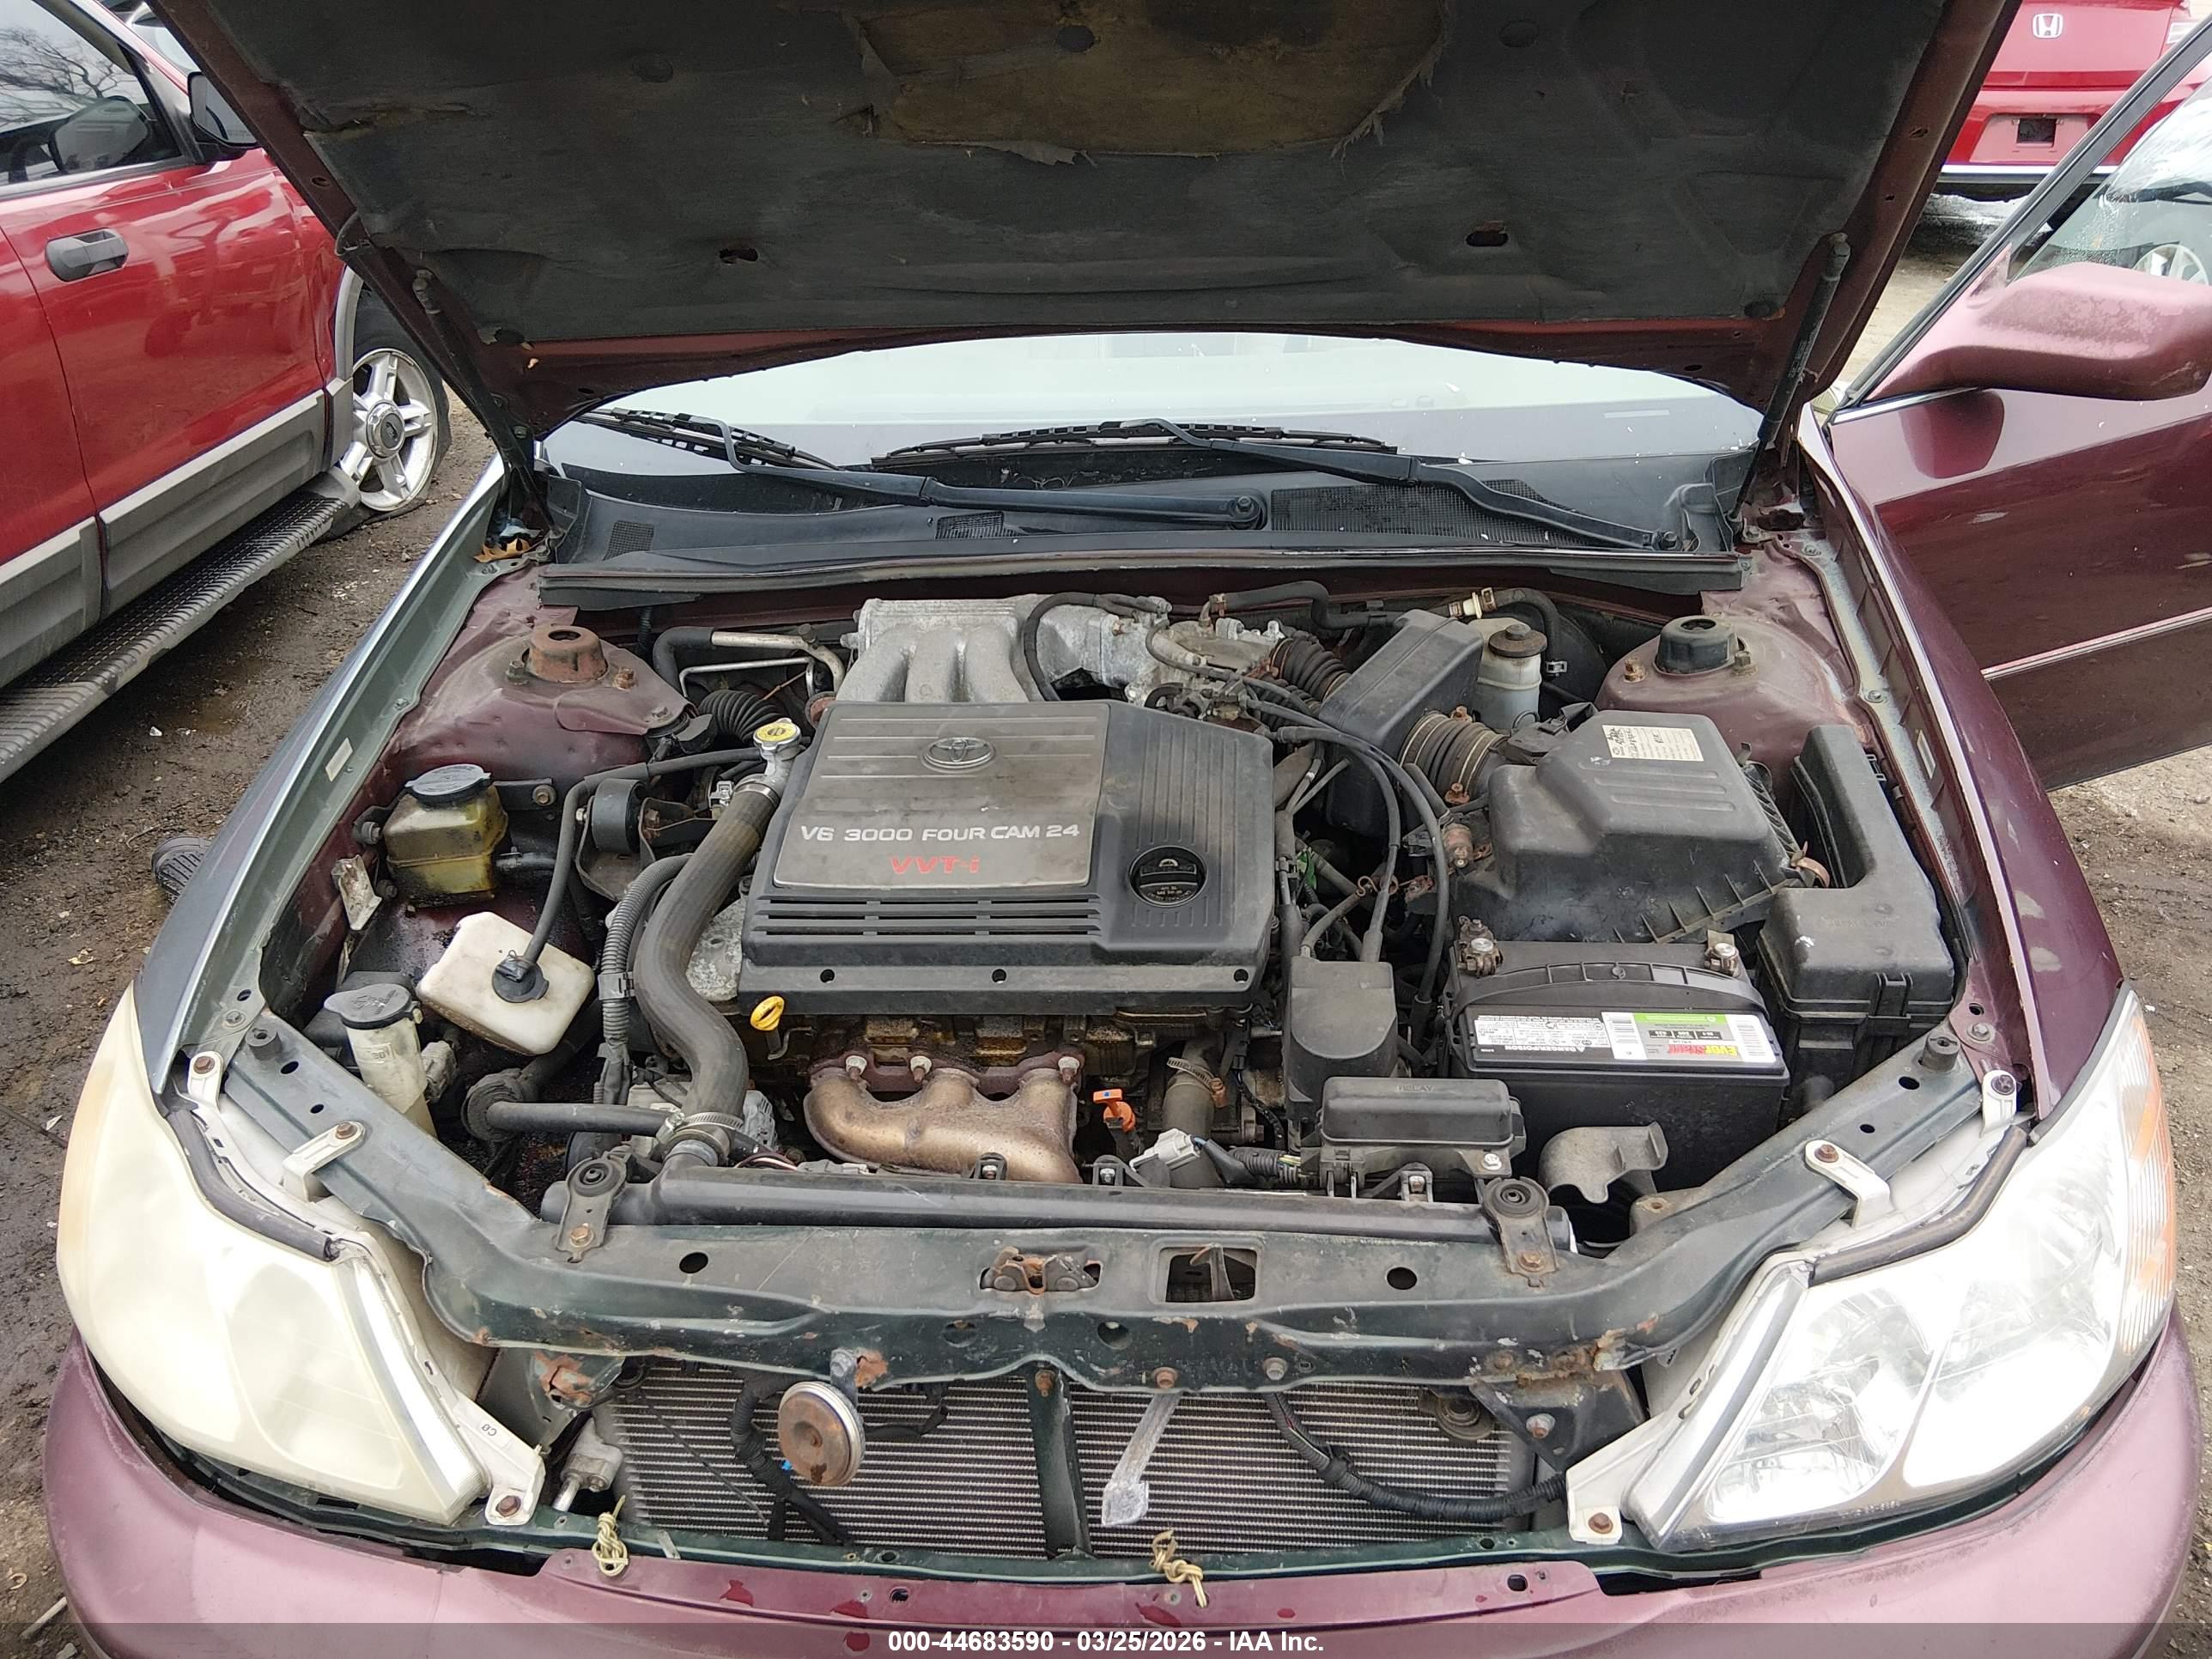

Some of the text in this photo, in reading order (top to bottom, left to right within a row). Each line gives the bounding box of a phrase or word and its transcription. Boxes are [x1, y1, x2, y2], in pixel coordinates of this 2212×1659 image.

[801, 823, 1080, 841] V6 3000 FOUR CAM 24
[890, 856, 981, 874] VVT-i
